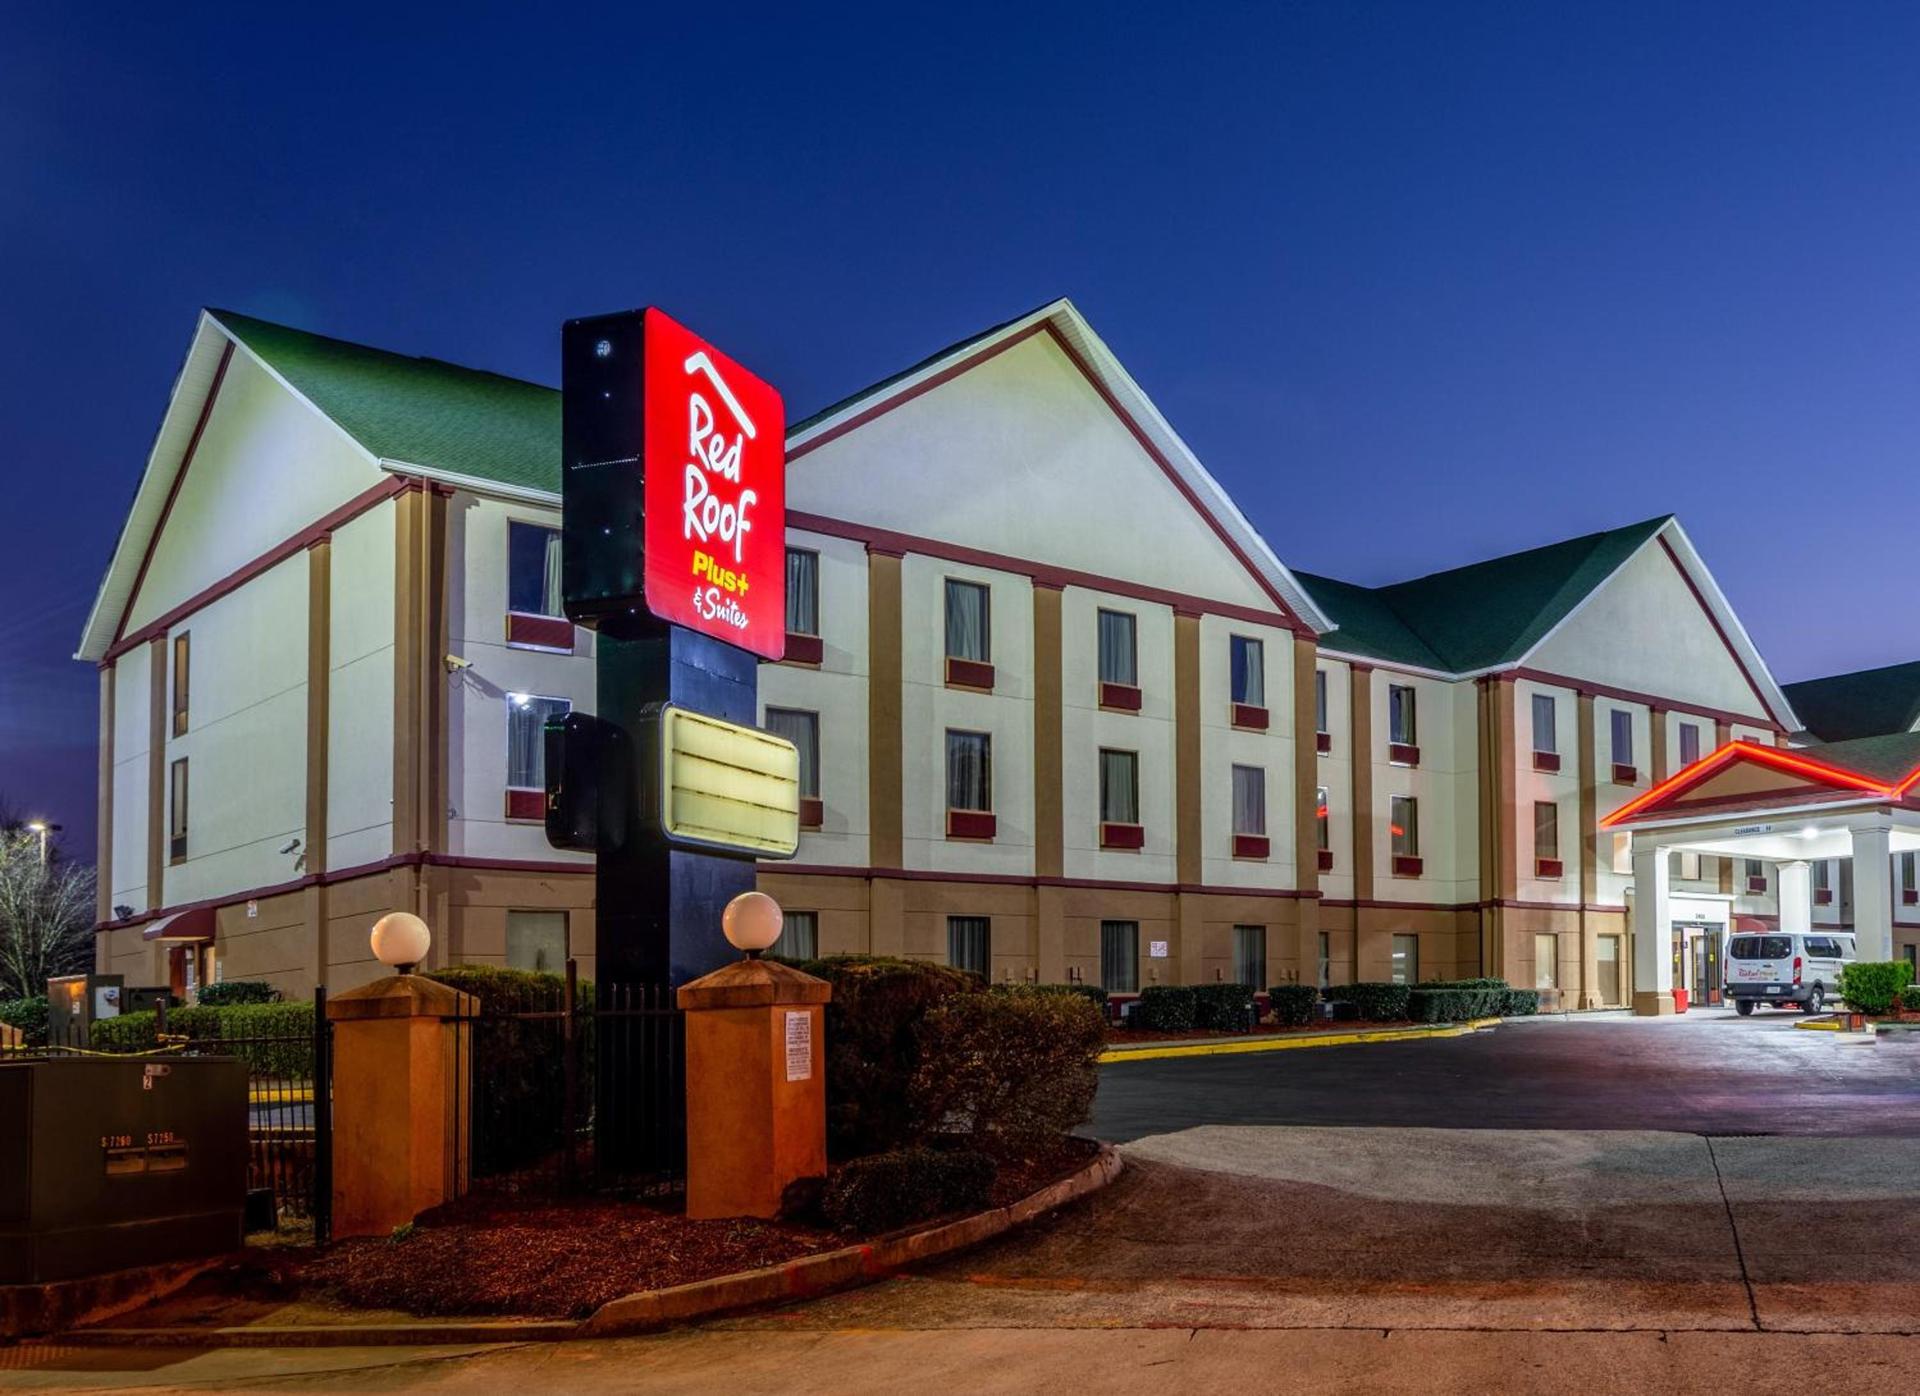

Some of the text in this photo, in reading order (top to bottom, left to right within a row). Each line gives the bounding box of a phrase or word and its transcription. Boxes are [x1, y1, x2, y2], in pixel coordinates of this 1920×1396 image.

[689, 392, 743, 483] Red
[684, 464, 757, 564] Roof
[693, 586, 748, 629] & Suites
